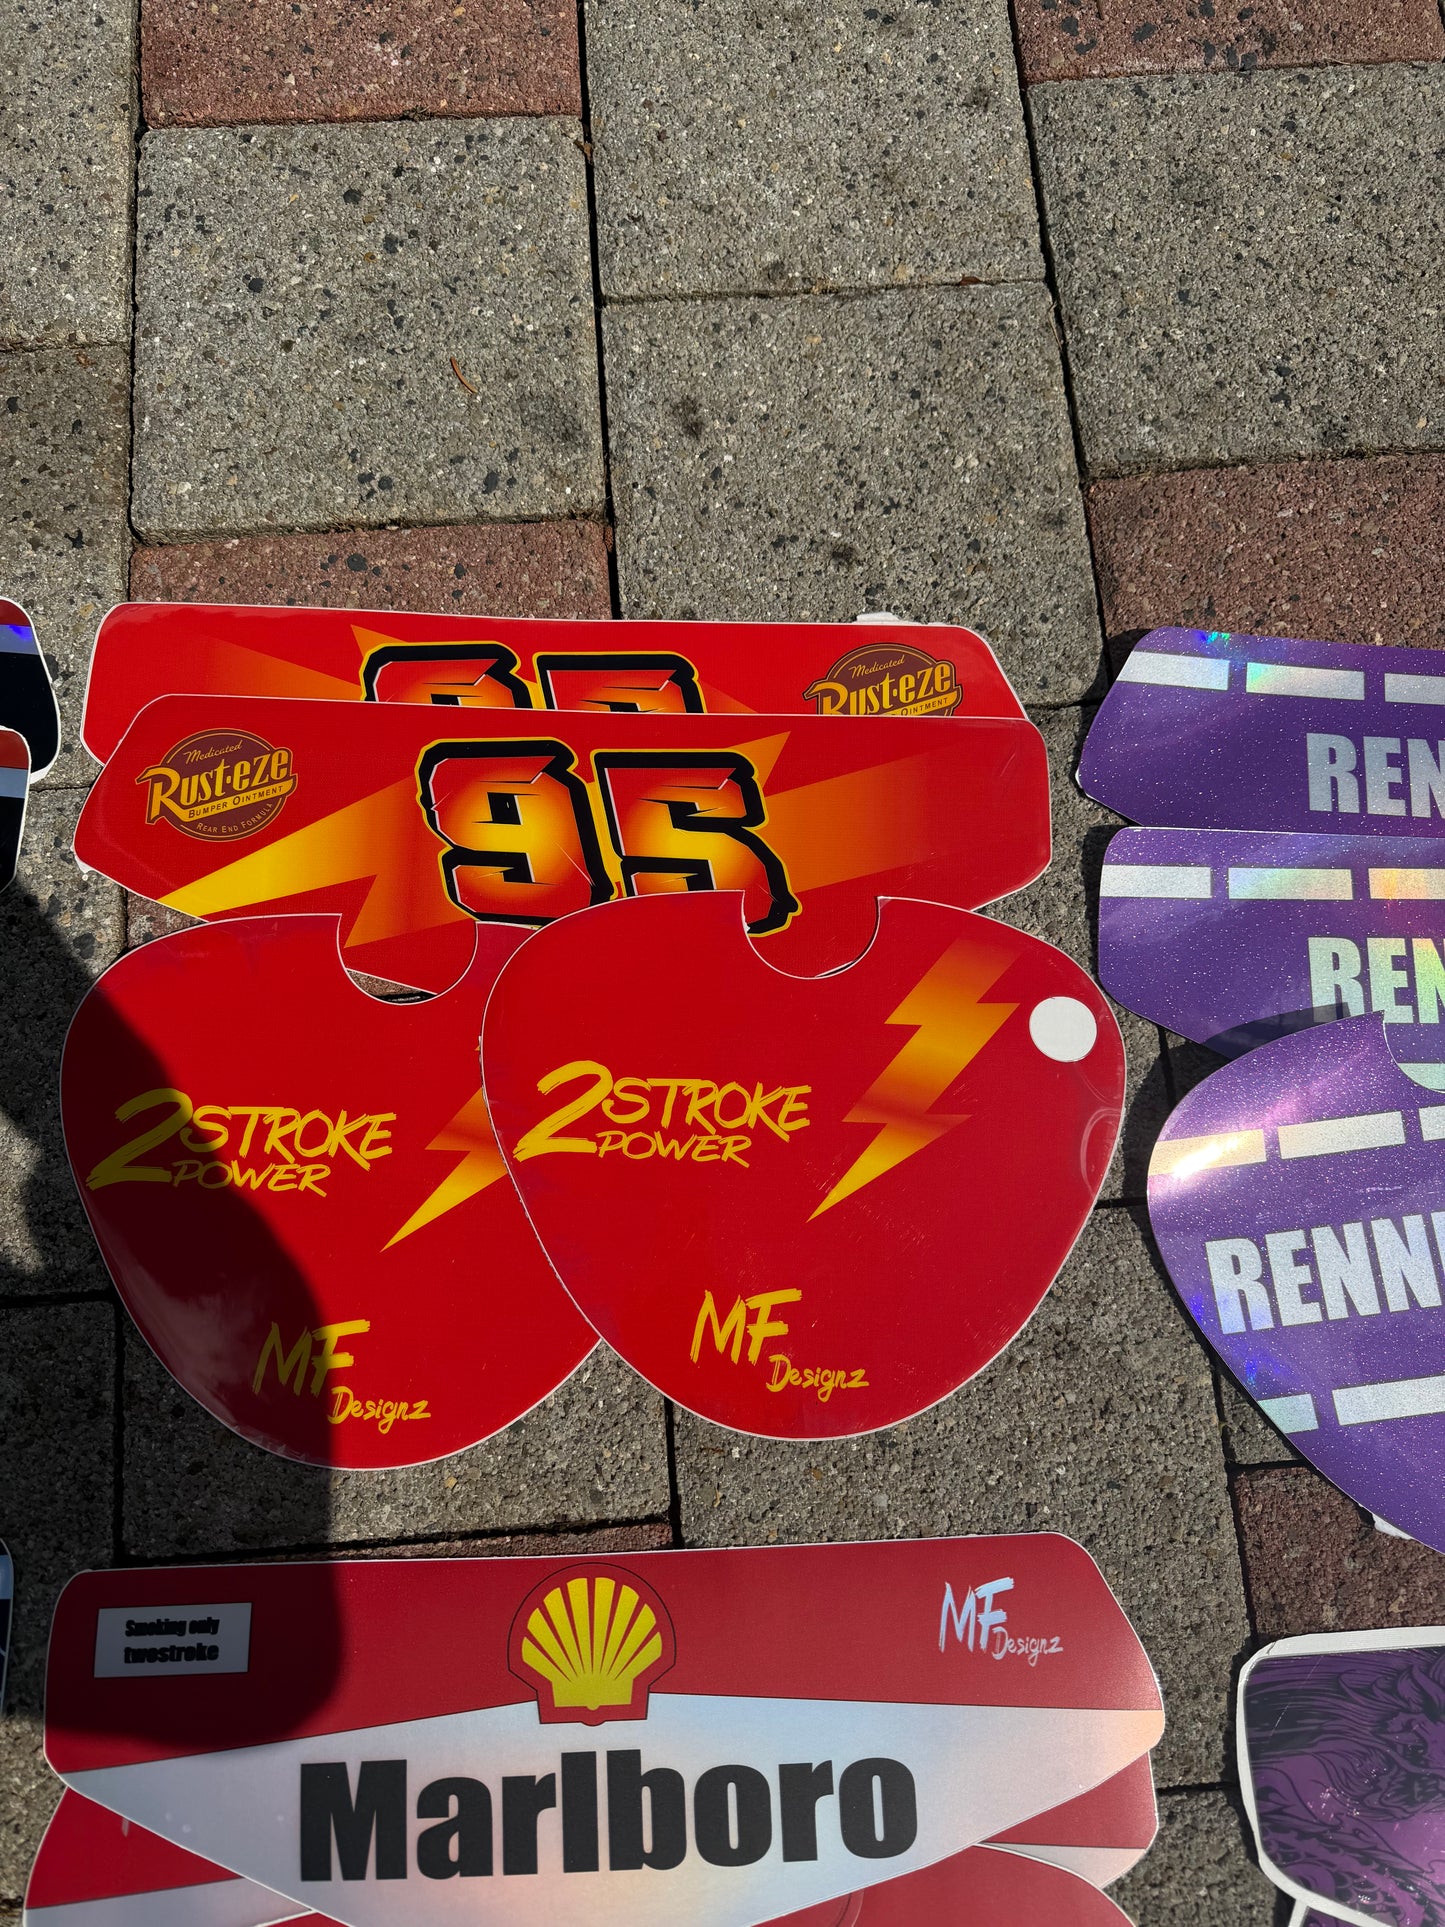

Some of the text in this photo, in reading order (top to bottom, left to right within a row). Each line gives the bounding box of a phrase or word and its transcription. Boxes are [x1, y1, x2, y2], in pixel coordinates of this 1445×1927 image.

[849, 654, 905, 679] Medicated
[183, 739, 242, 765] Medicated
[596, 1131, 751, 1168] POWER
[171, 1159, 331, 1197] POWER
[690, 1288, 802, 1366] MF
[252, 1319, 371, 1396] MF
[766, 1354, 869, 1403] Designz
[327, 1386, 431, 1433] Designz
[125, 1618, 187, 1637] Smoking
[938, 1577, 1014, 1653] MF
[991, 1626, 1063, 1667] Designz
[300, 1749, 917, 1882] Marlboro
